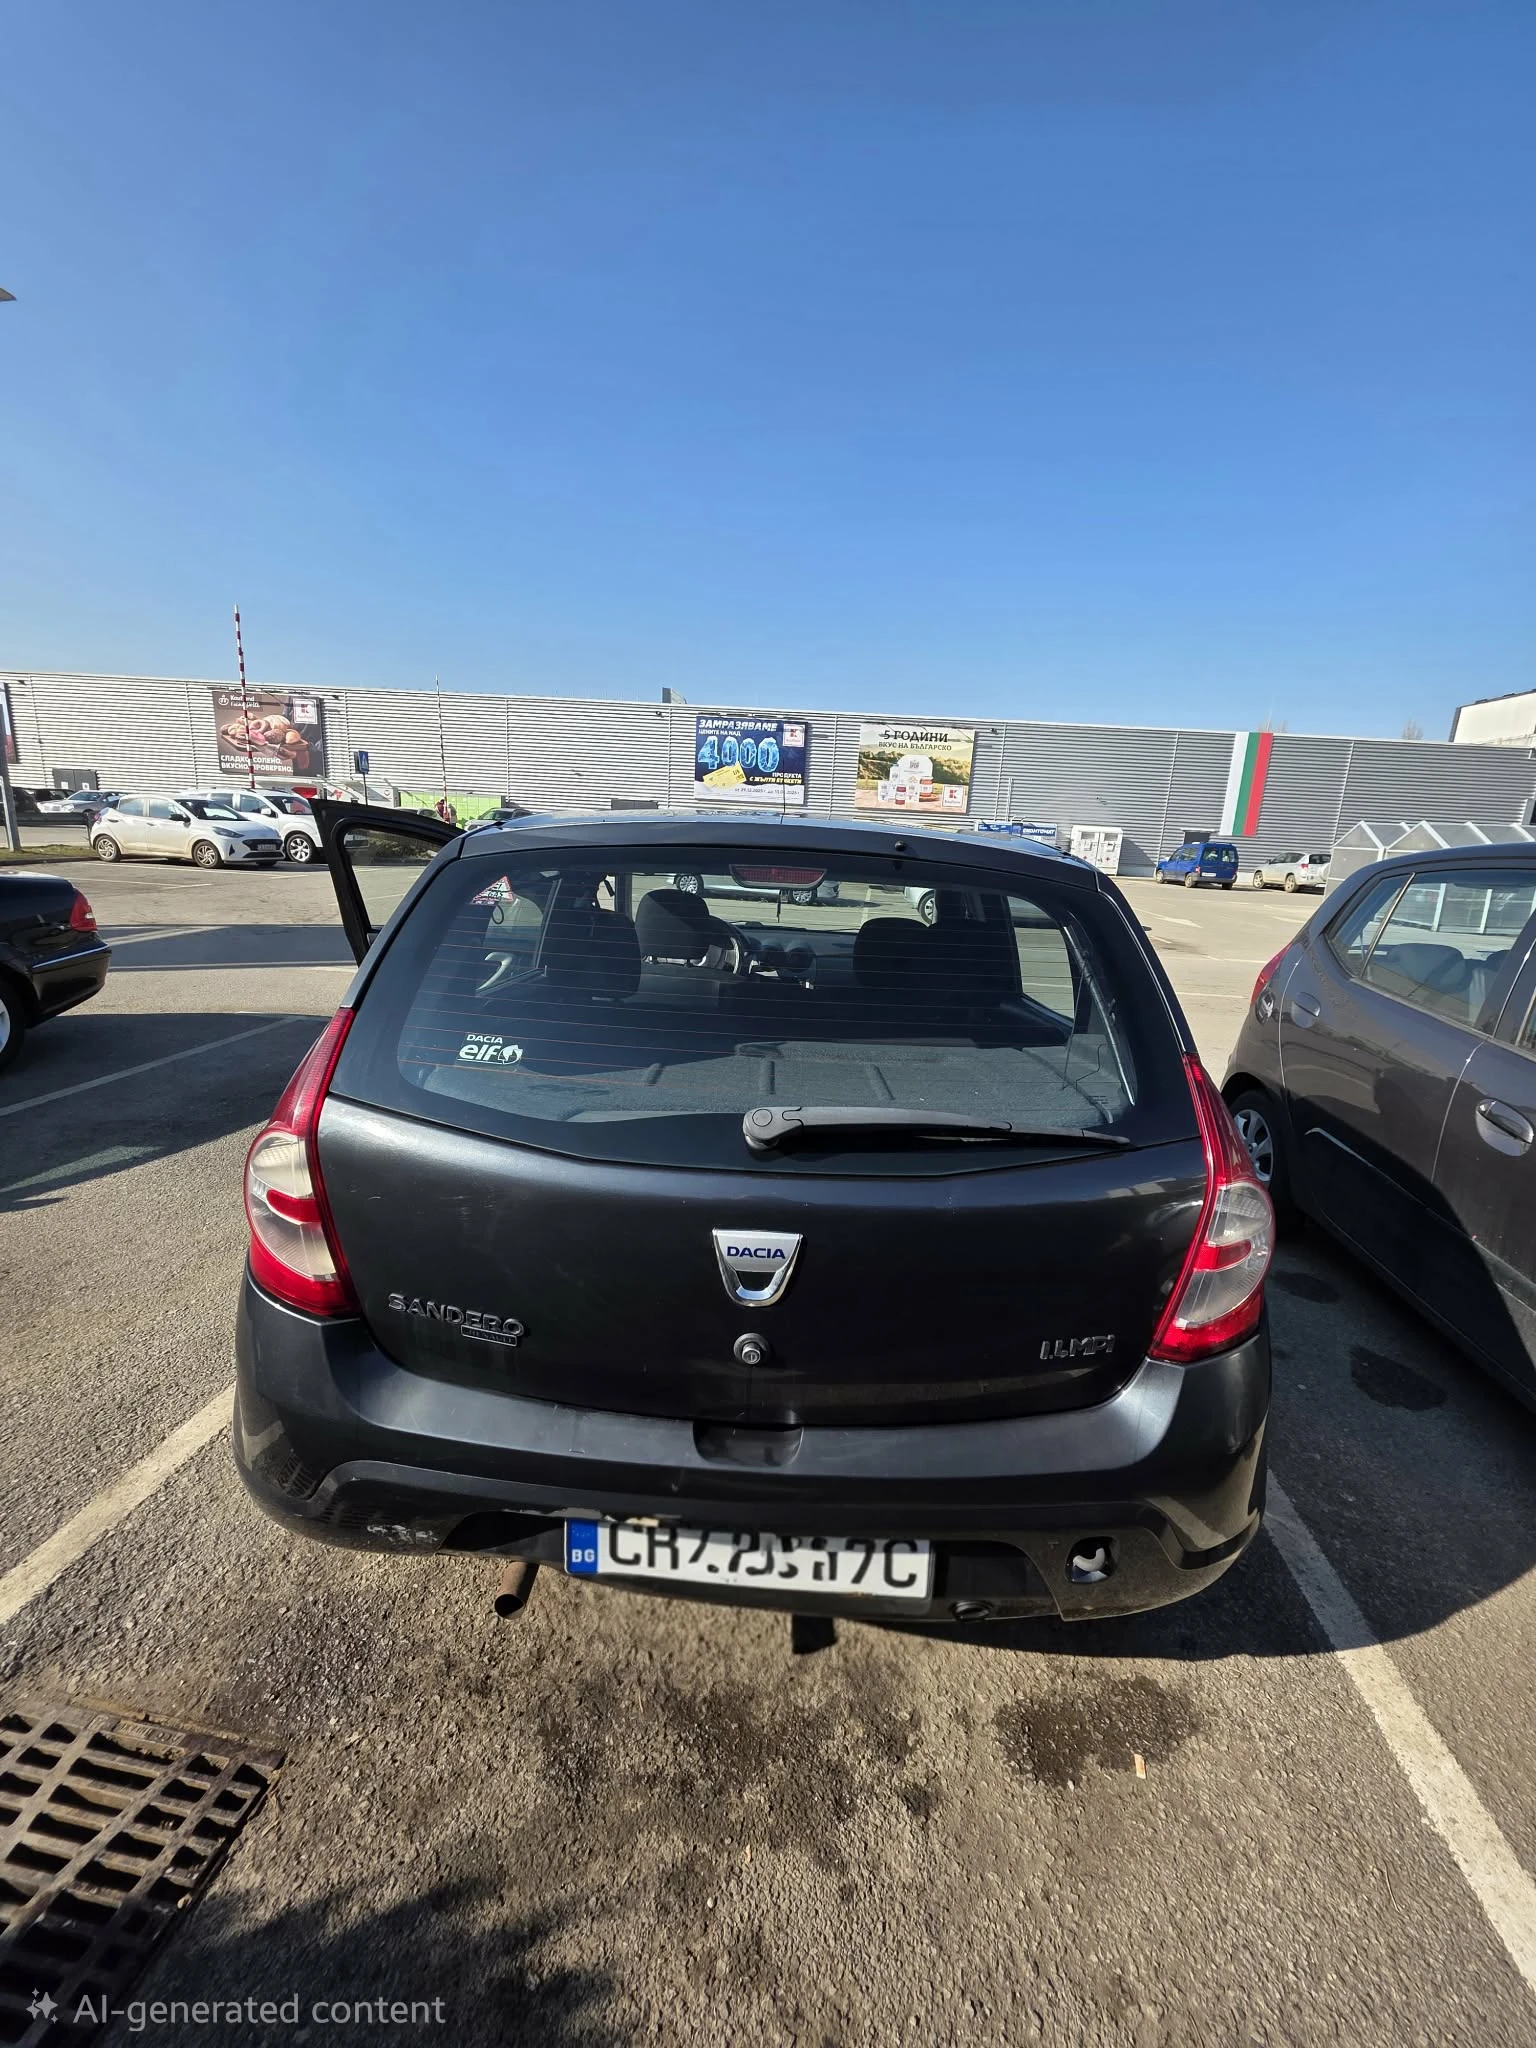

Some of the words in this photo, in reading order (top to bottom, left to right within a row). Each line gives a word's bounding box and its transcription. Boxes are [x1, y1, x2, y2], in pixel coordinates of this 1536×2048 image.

[698, 719, 778, 732] ЗАМРАЗЯВАМЕ
[883, 730, 891, 740] 5
[893, 731, 948, 743] ГОДИНИ
[878, 741, 897, 749] ВКУС
[910, 743, 952, 751] БЪЛГАРСКО
[698, 736, 779, 773] 4000
[466, 1034, 503, 1044] DACIA
[459, 1044, 501, 1060] elf
[727, 1246, 786, 1259] DACIA
[388, 1292, 524, 1336] SANDERO
[571, 1549, 595, 1563] BG
